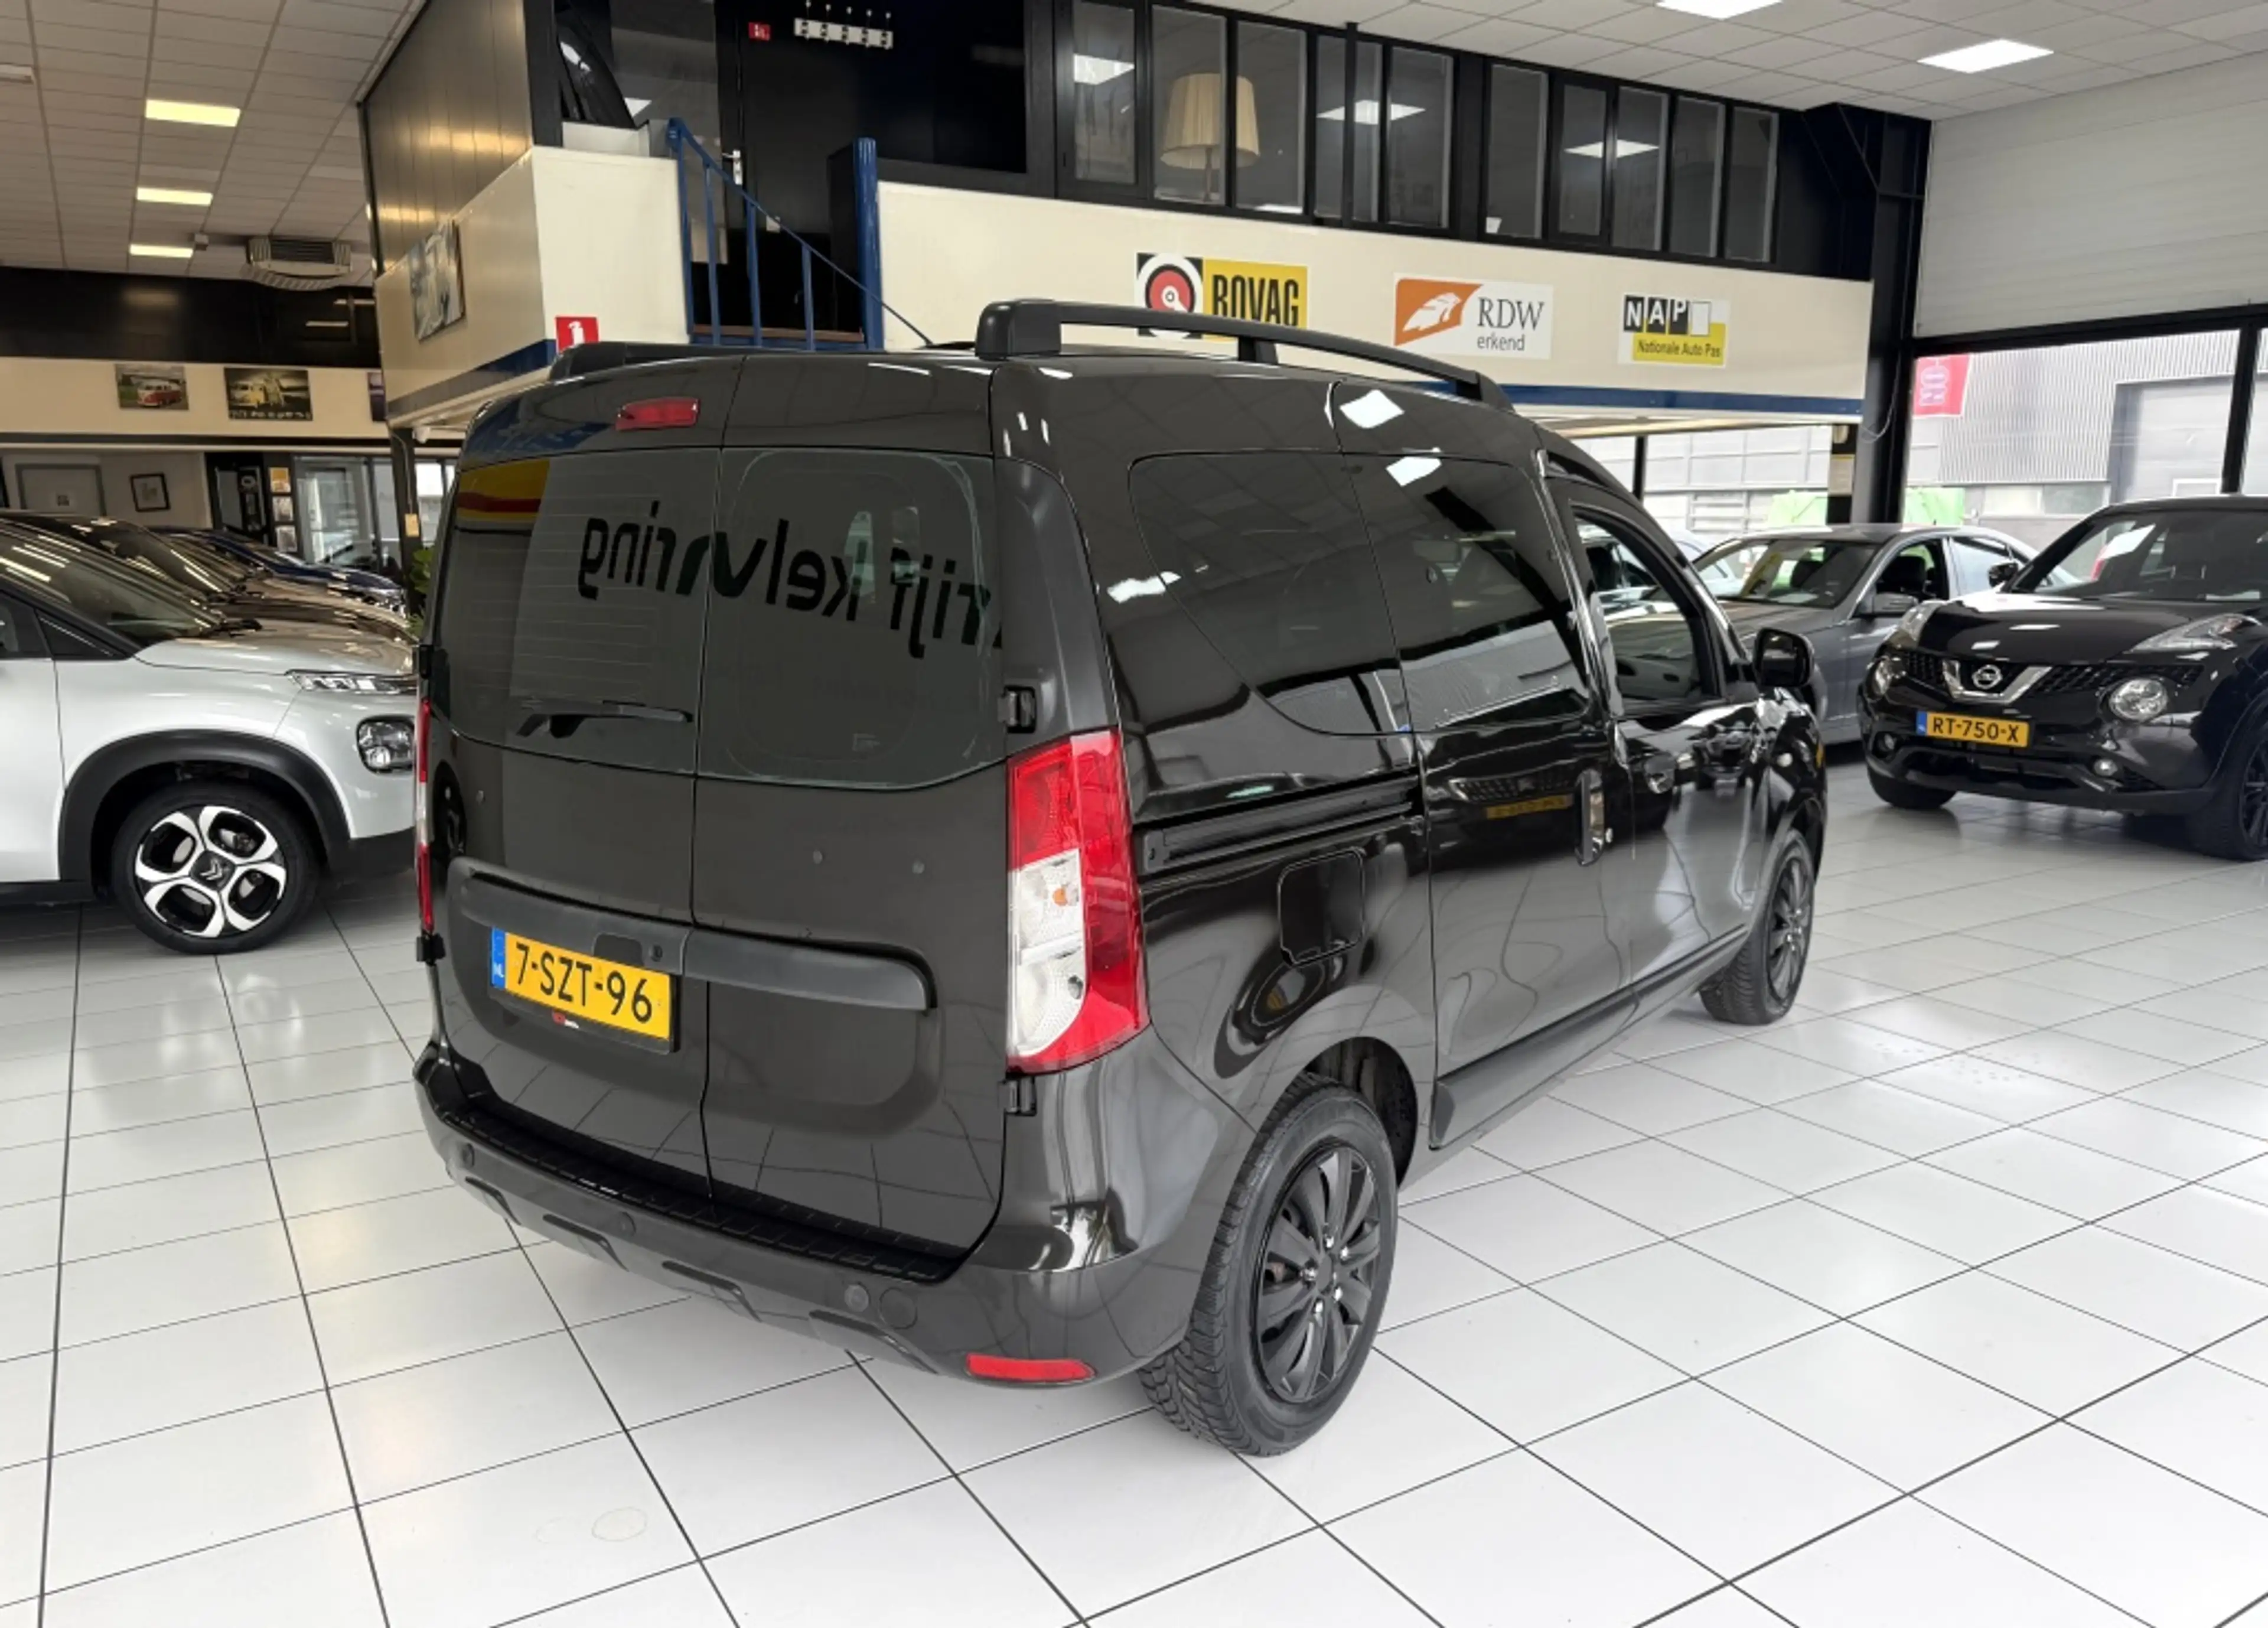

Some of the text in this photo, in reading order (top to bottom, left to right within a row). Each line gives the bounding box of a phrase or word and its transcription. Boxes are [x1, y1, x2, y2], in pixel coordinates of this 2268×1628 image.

[1213, 274, 1299, 327] BOVAG
[1477, 297, 1545, 331] RDW
[1626, 299, 1687, 328] NAP
[1477, 331, 1526, 351] erkend
[1637, 339, 1721, 357] Nationale Auto Pas
[1933, 717, 2019, 743] RT-750-X
[516, 942, 652, 1024] 7-SZT-96
